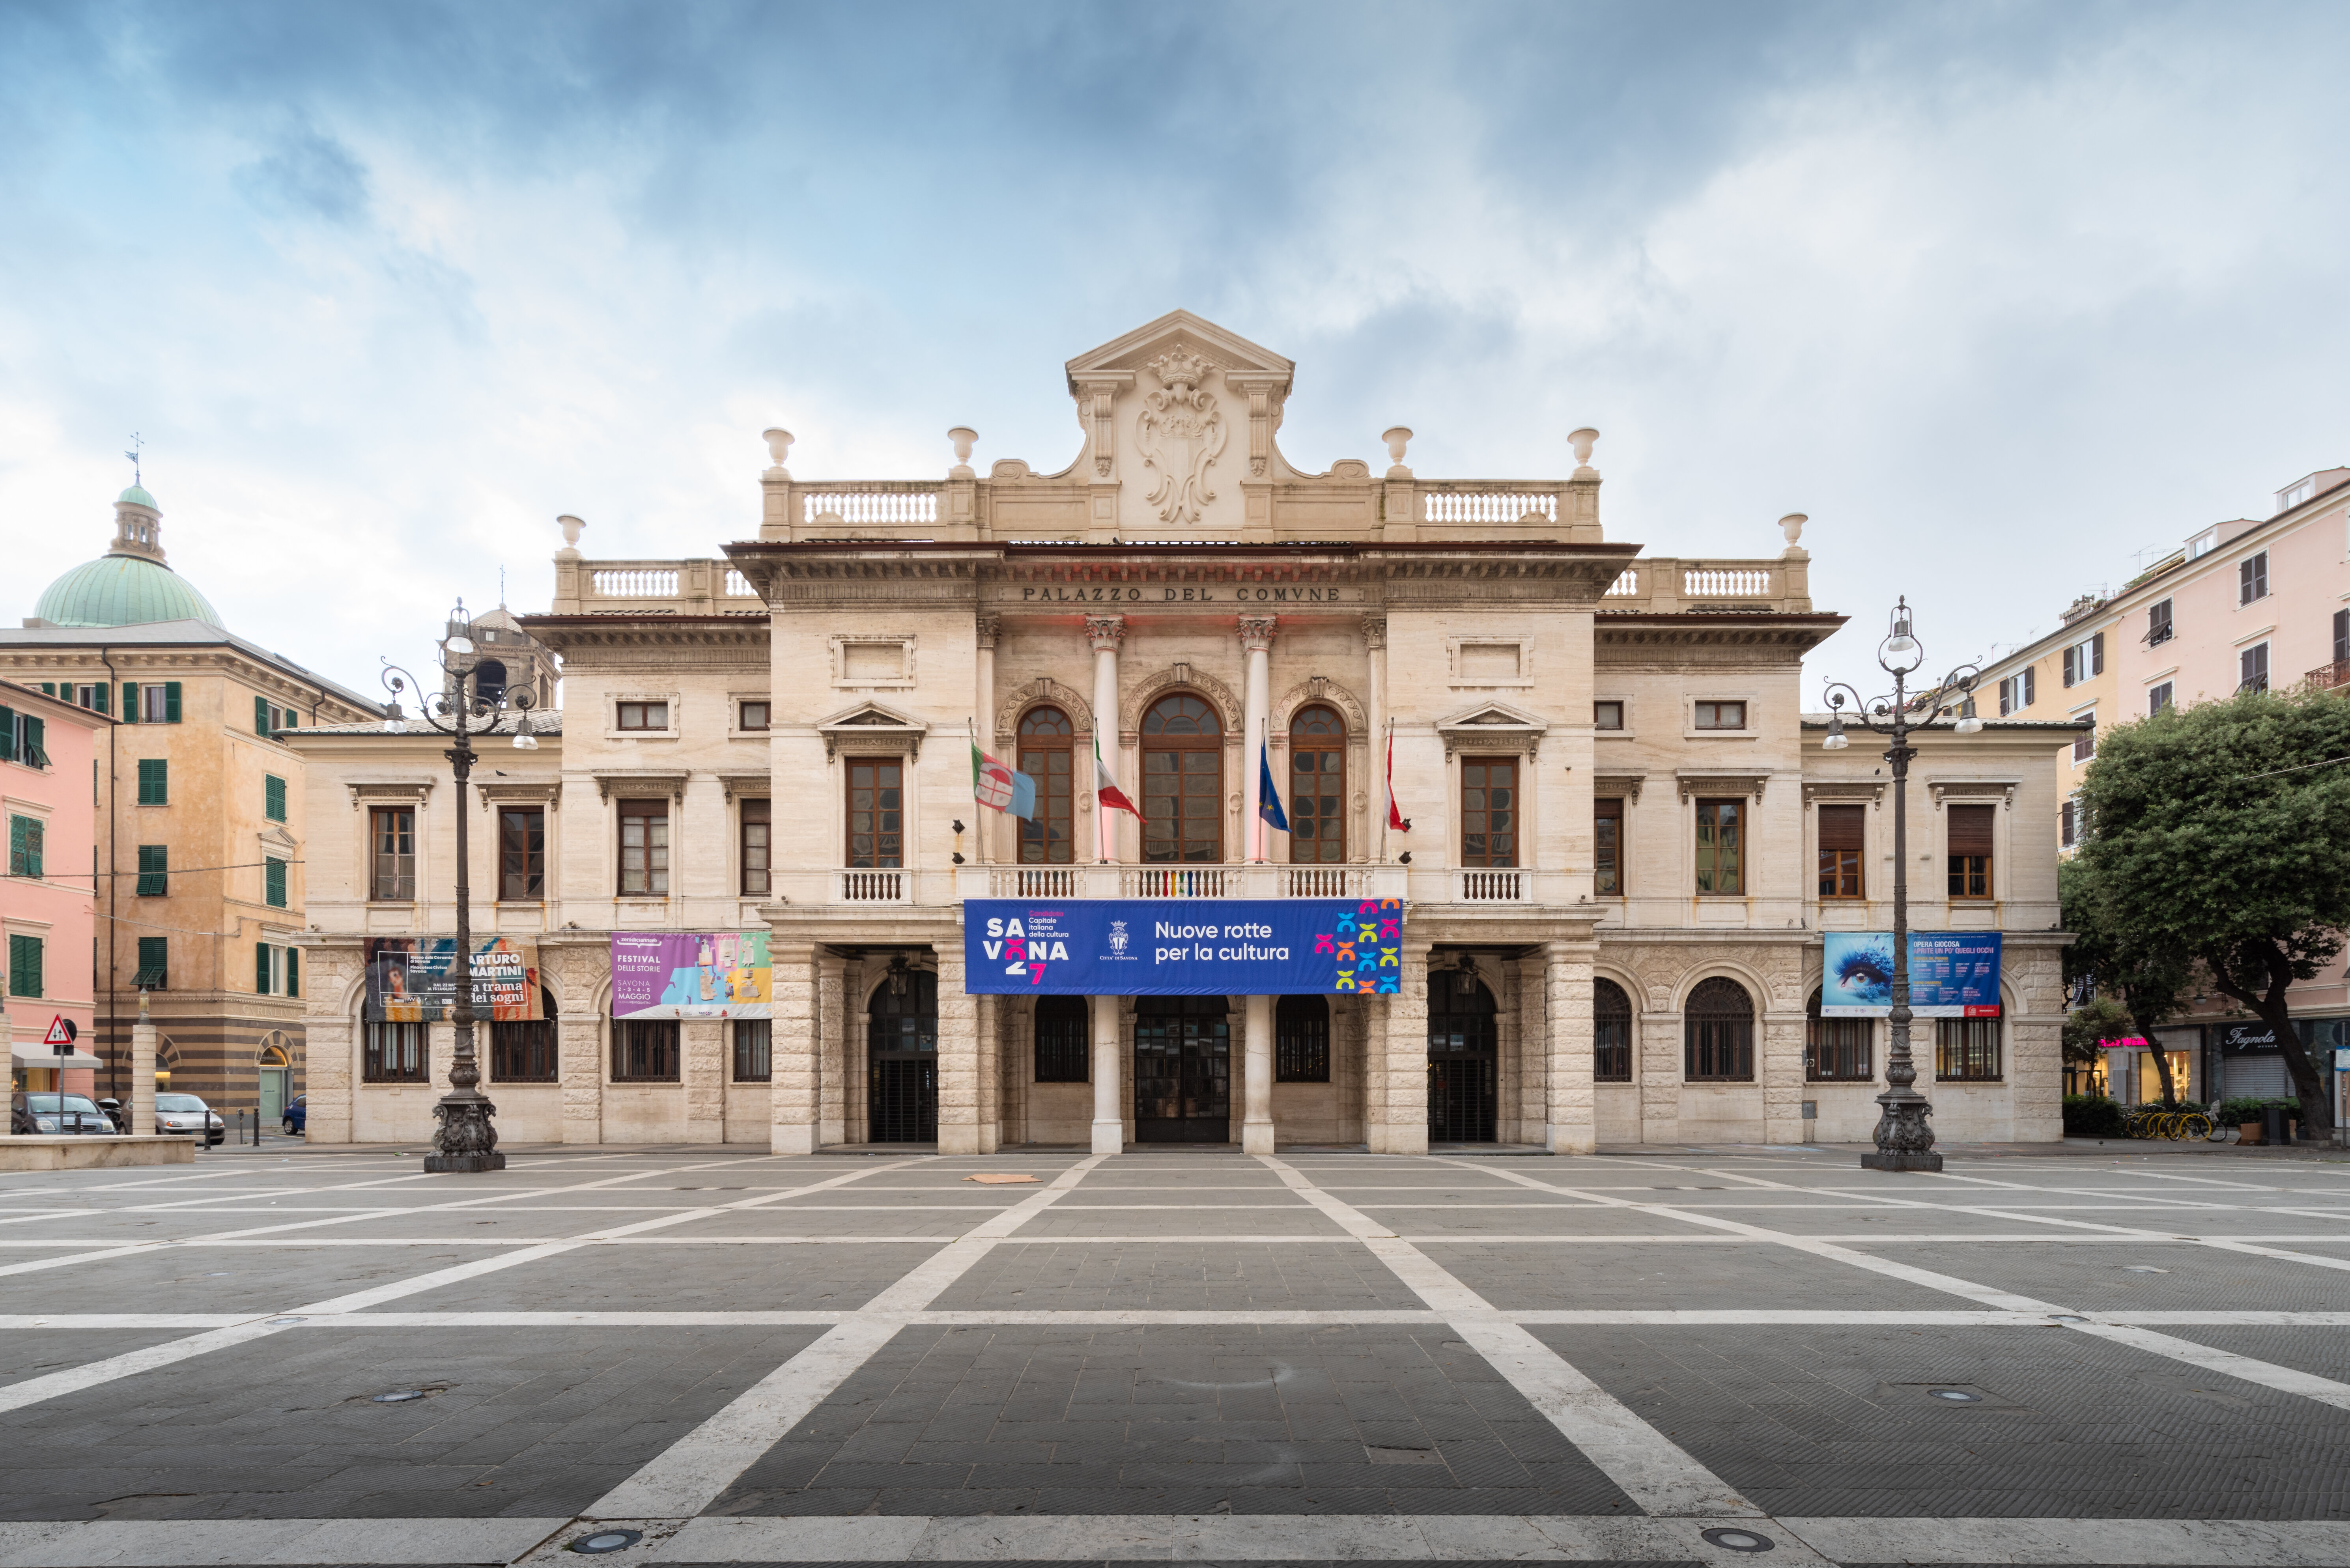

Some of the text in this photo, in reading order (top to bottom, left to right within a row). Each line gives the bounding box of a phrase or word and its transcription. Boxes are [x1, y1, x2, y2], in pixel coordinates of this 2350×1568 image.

[1023, 588, 1339, 600] PALAZZO DEL COMVNE
[1156, 922, 1272, 938] Nuove rotte
[469, 954, 520, 965] ARTURO
[1156, 943, 1289, 965] per la cultura
[469, 966, 521, 976] MARTINI
[482, 982, 523, 991] trama
[490, 991, 525, 1004] sogni
[2225, 1027, 2276, 1049] Fagnola
